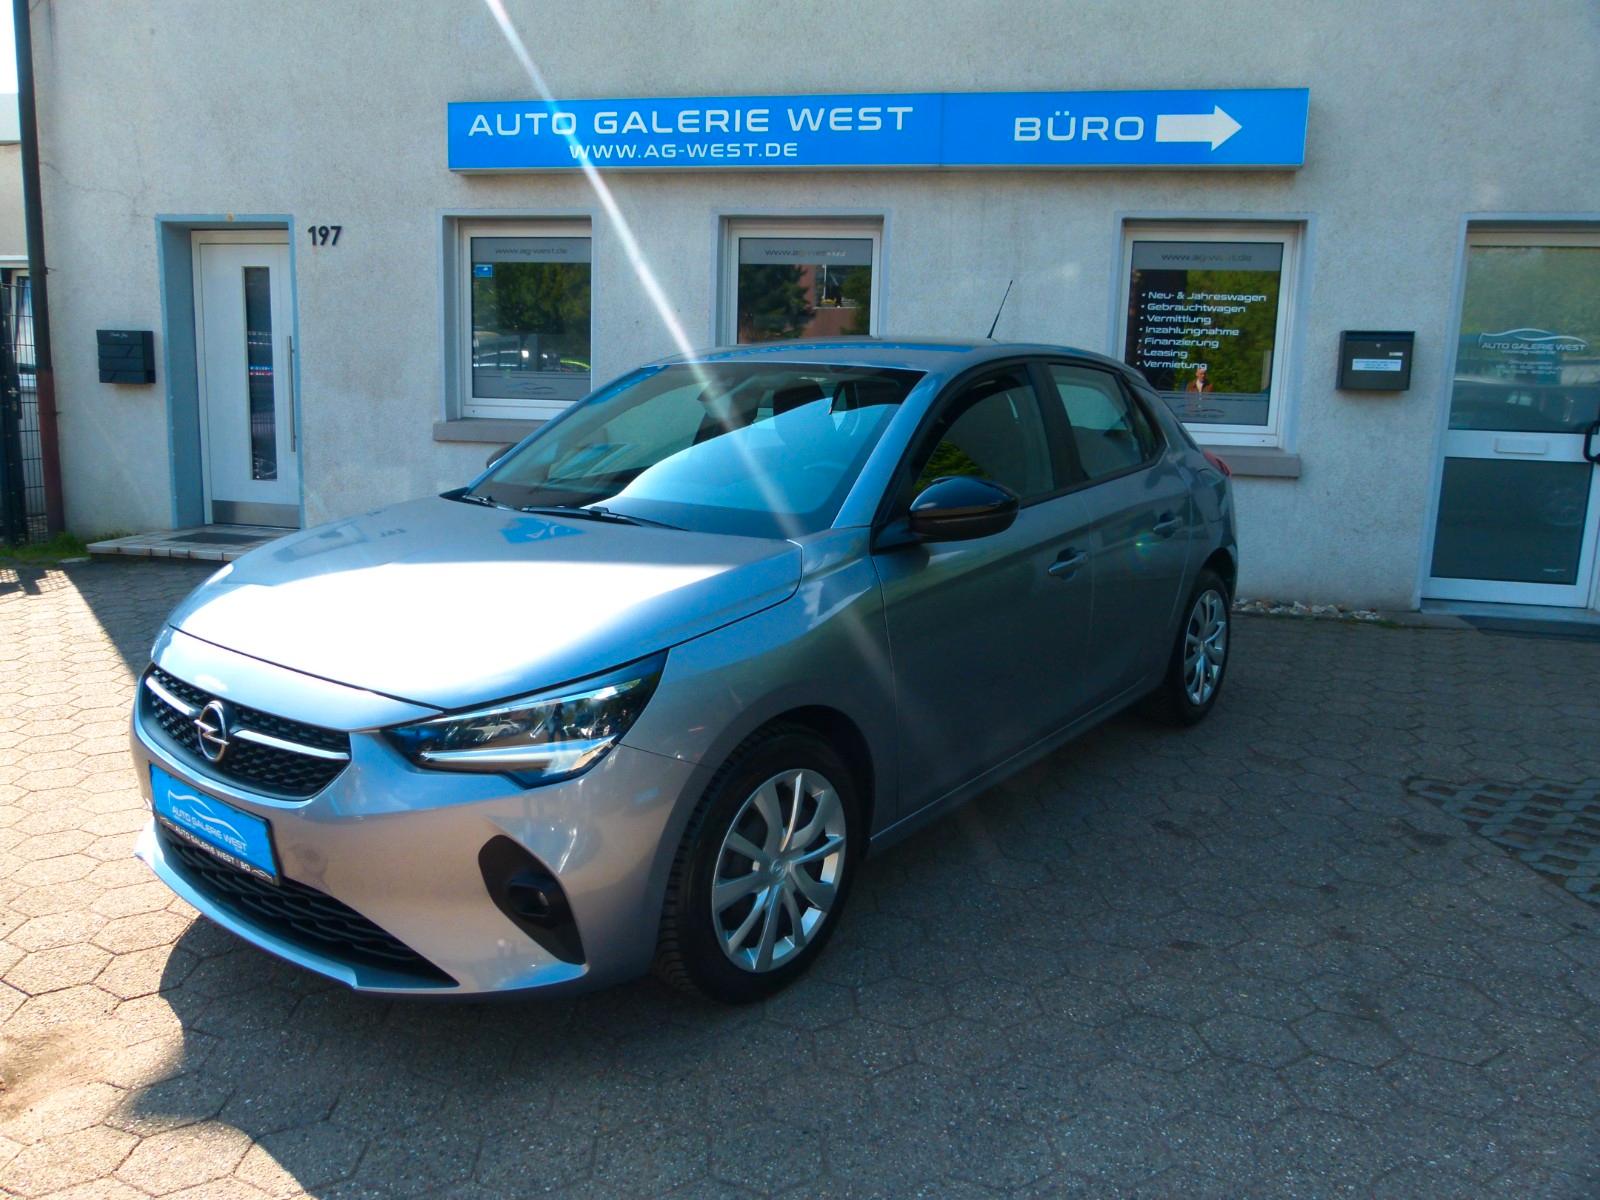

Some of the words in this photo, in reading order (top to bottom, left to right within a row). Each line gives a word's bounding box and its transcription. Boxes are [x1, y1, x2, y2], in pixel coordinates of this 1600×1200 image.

[469, 113, 577, 136] AUTO
[594, 108, 770, 134] GALERIE
[787, 106, 914, 131] WEST
[1014, 110, 1145, 141] BÜRO
[569, 142, 799, 159] WWW.AG-WEST.DE
[307, 226, 342, 246] 197
[1148, 291, 1174, 300] Neu-
[1177, 291, 1184, 300] &
[1187, 292, 1266, 303] Jahreswagen
[1147, 303, 1246, 314] Gebrauchtwagen
[1146, 314, 1212, 325] Vermittlung
[1145, 326, 1239, 336] Inzahlungnahme
[1144, 337, 1219, 348] Finanzierung
[1481, 342, 1509, 350] AUTO
[1556, 343, 1586, 351] WEST
[1143, 349, 1188, 359] Leasing
[1143, 360, 1207, 371] Vermietung
[172, 805, 191, 822] AUTO
[223, 832, 247, 852] WEST
